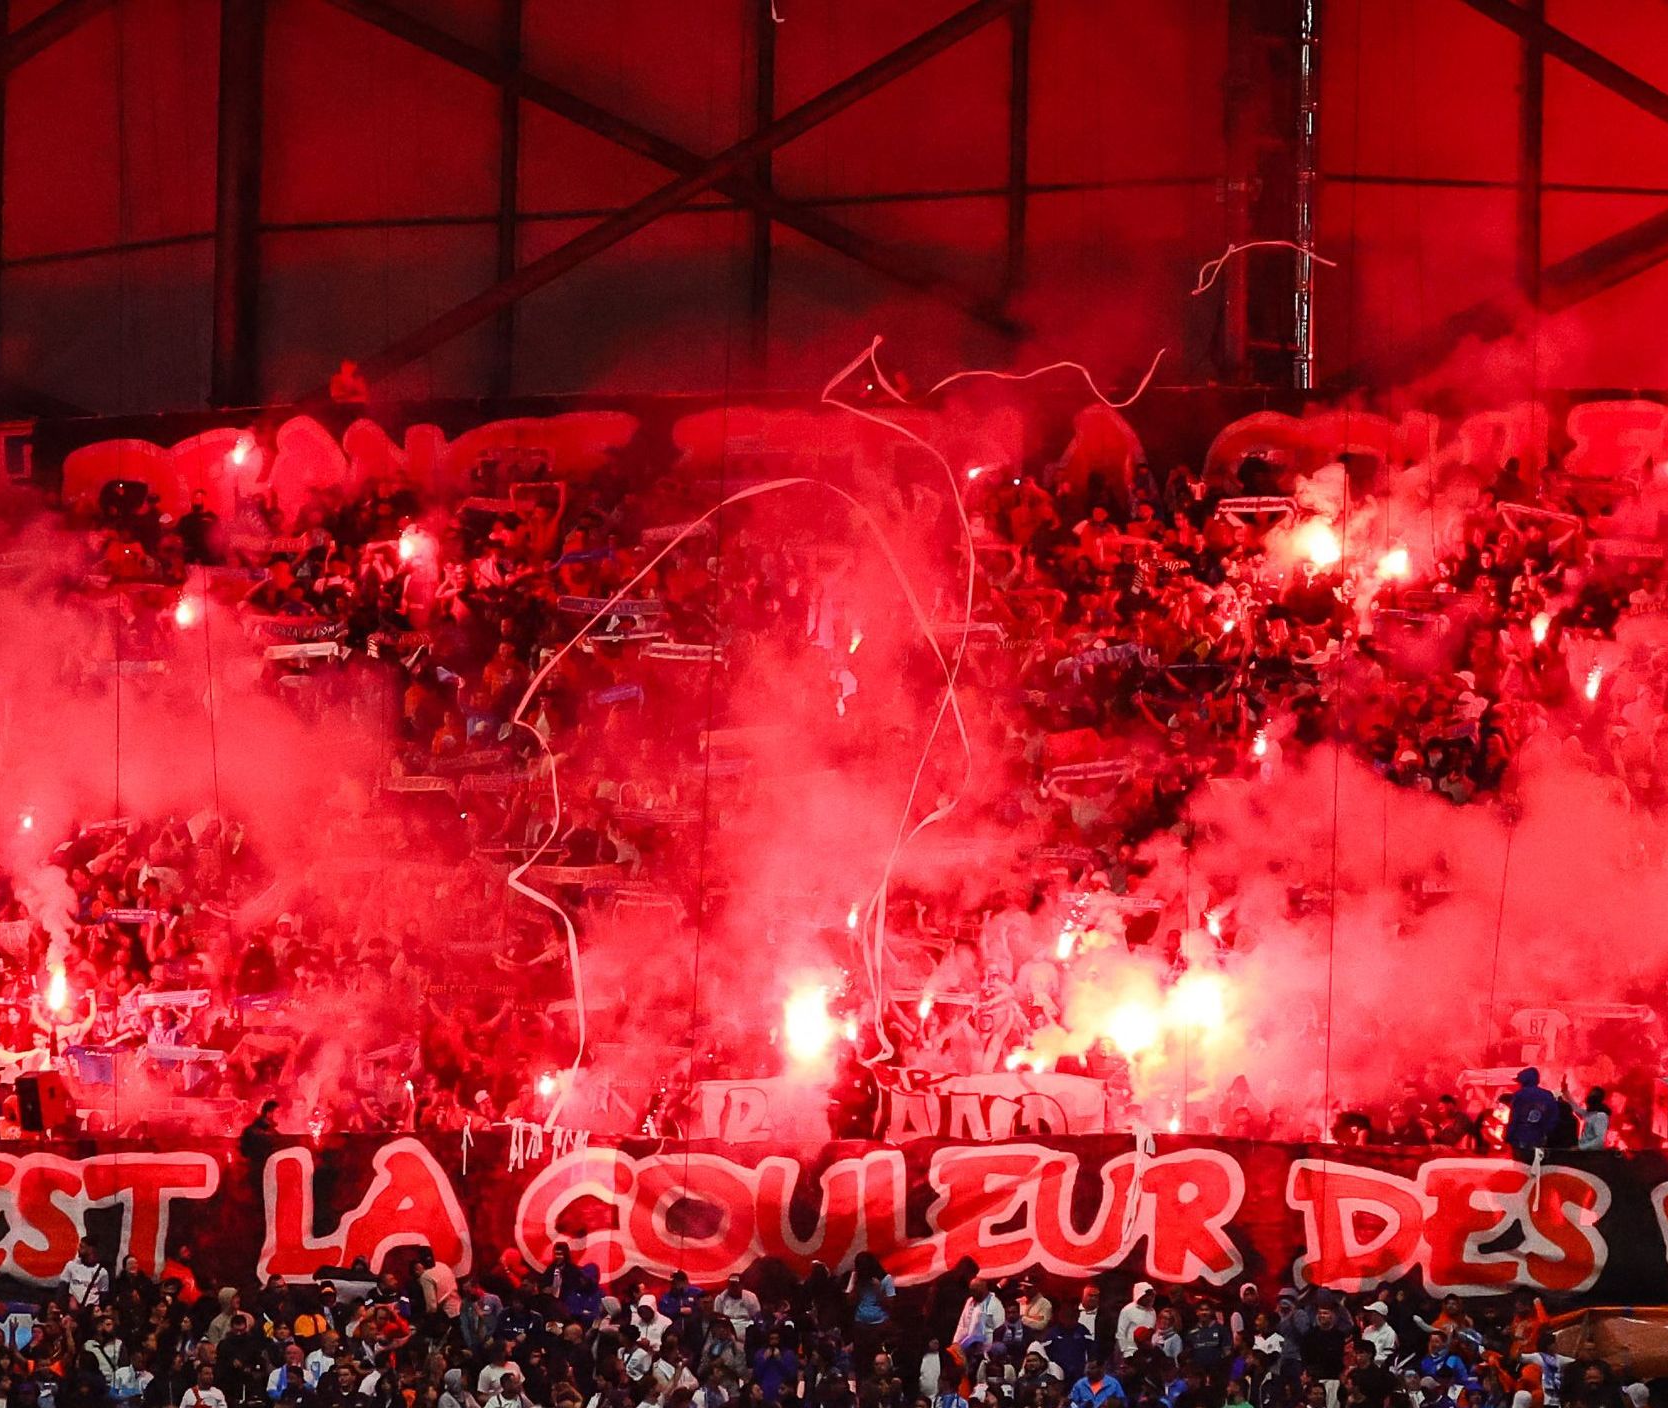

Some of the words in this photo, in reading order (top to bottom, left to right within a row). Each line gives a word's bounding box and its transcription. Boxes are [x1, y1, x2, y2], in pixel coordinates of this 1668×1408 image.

[257, 1137, 472, 1286] LA
[516, 1144, 1244, 1286] COULEUR
[1286, 1157, 1611, 1297] DES
